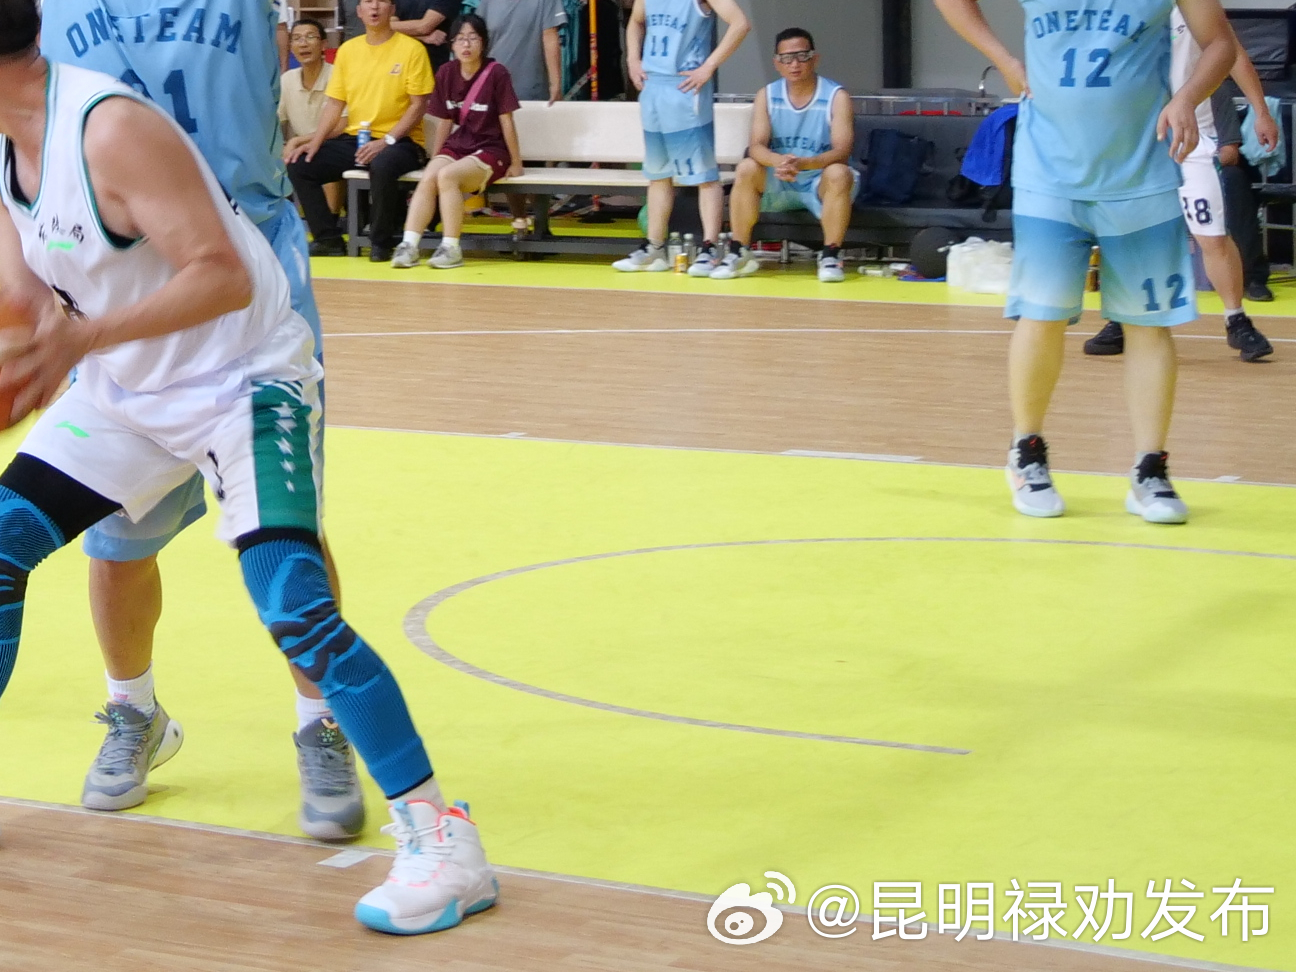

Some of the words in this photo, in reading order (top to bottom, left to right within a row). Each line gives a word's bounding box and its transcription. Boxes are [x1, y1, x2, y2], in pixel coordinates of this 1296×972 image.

[650, 35, 670, 57] 11
[1059, 47, 1113, 88] 12
[674, 158, 695, 176] 11
[1141, 273, 1190, 312] 12
